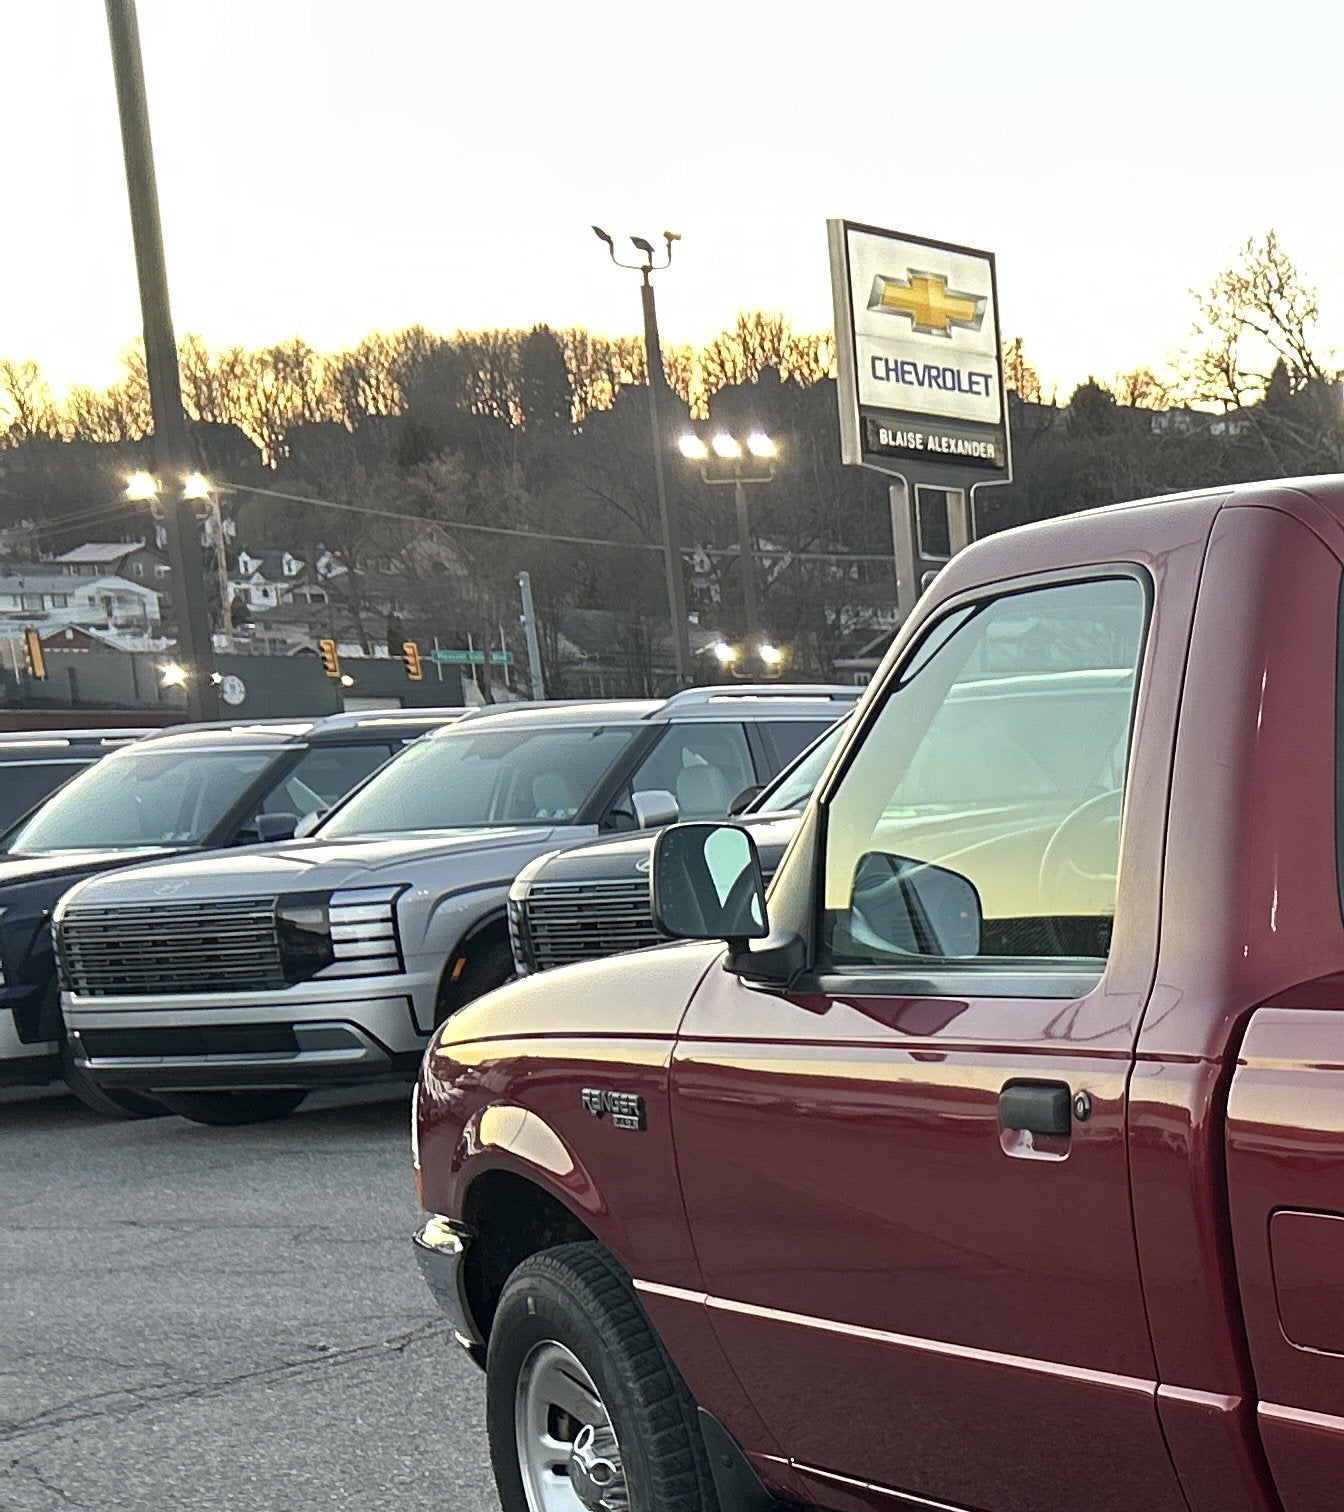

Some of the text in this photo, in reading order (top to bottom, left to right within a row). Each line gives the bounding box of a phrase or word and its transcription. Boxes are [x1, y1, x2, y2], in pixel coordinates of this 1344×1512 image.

[870, 355, 993, 397] CHEVROLET
[879, 428, 995, 459] BLAISE ALEXANDER
